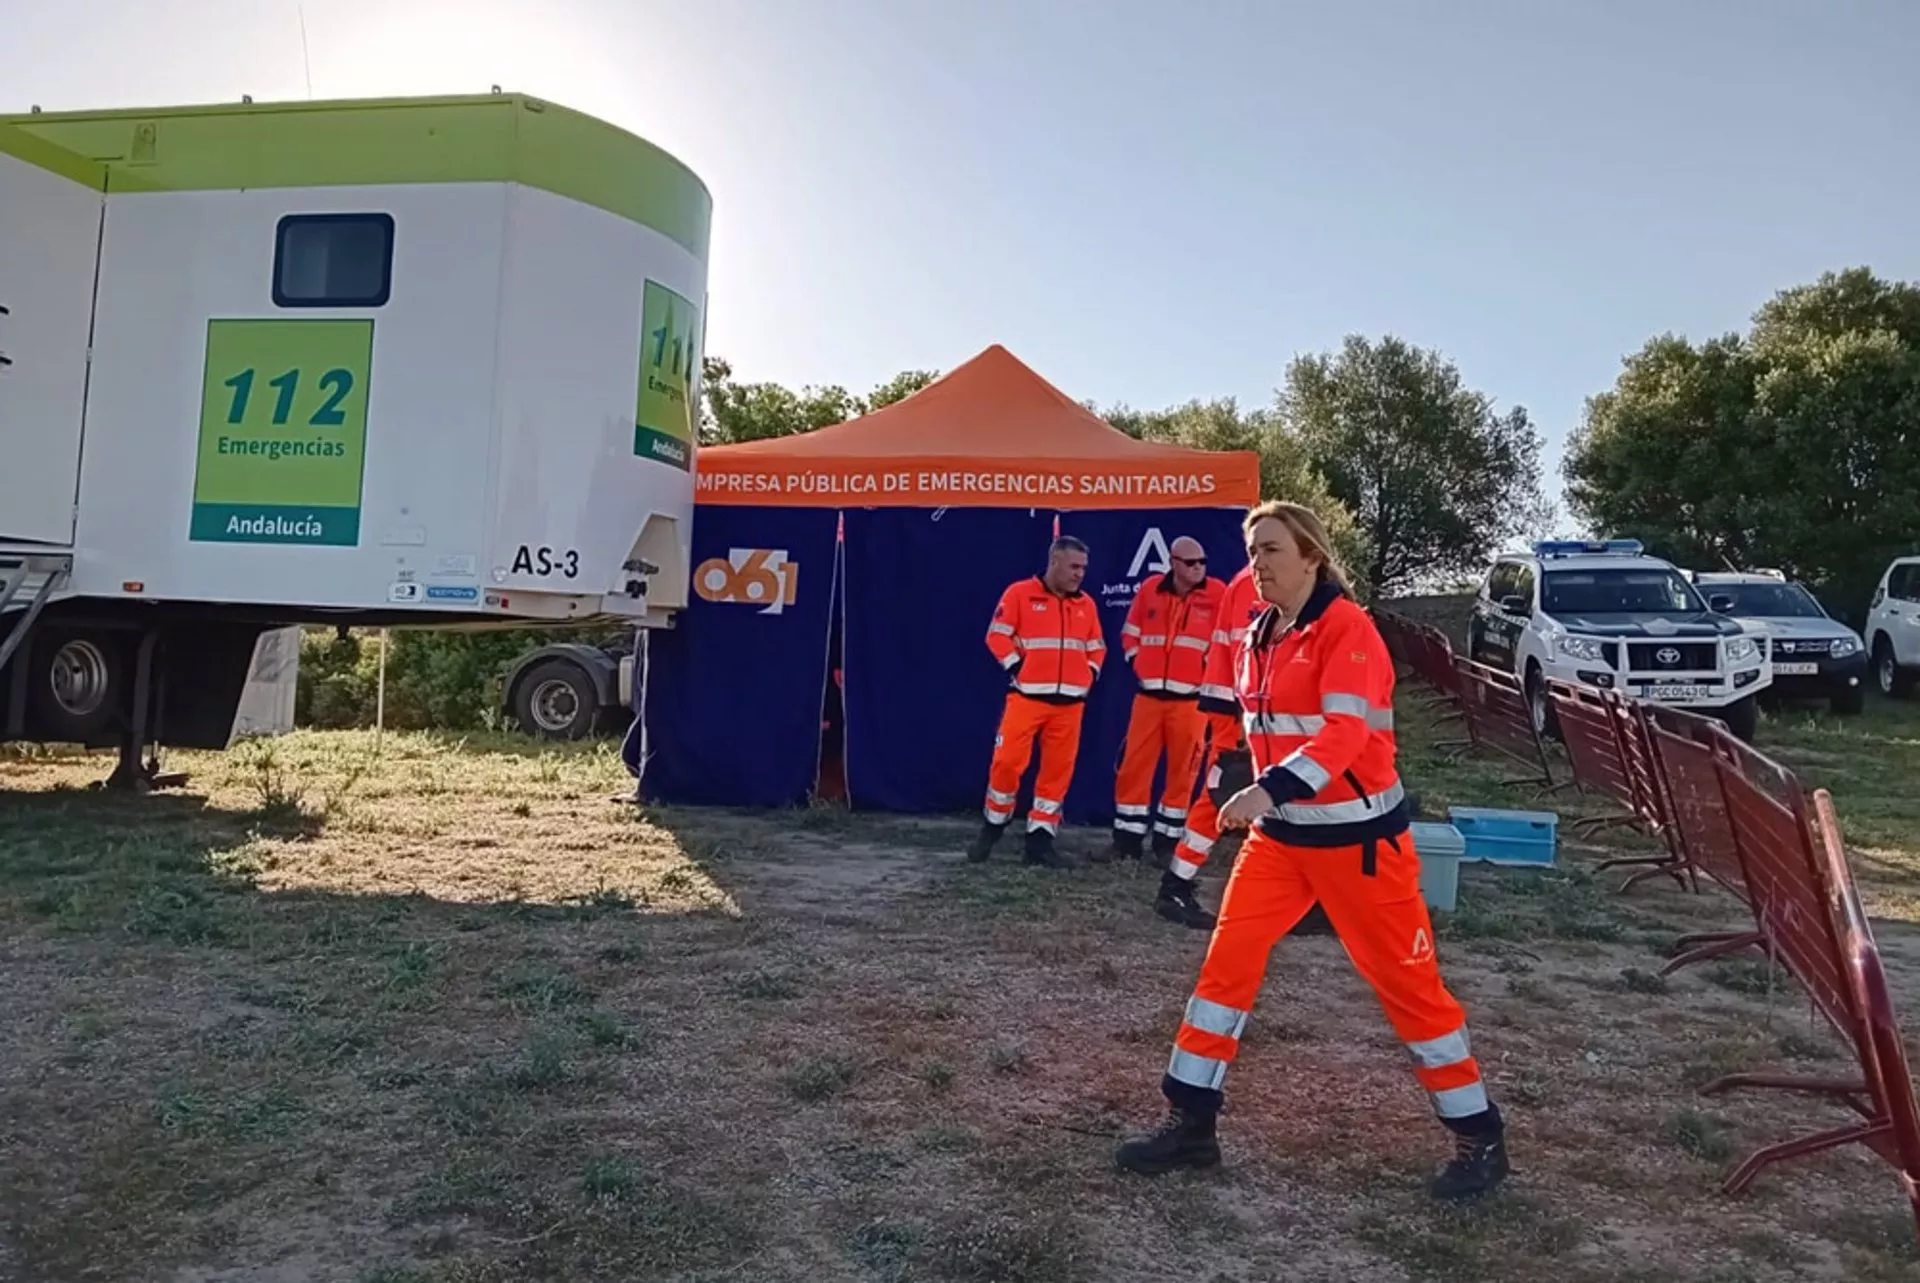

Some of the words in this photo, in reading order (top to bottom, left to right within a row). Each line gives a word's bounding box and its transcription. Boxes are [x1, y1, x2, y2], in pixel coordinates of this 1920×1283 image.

[224, 368, 355, 425] 112
[217, 436, 345, 461] Emergencias
[696, 472, 781, 492] MPRESA
[786, 470, 877, 493] PÚBLICA
[883, 473, 910, 491] DE
[917, 472, 1074, 495] EMERGENCIAS
[1079, 473, 1216, 495] SANITARIAS
[226, 514, 323, 537] Andalucía
[511, 545, 579, 579] AS-3
[1101, 583, 1131, 595] Junta
